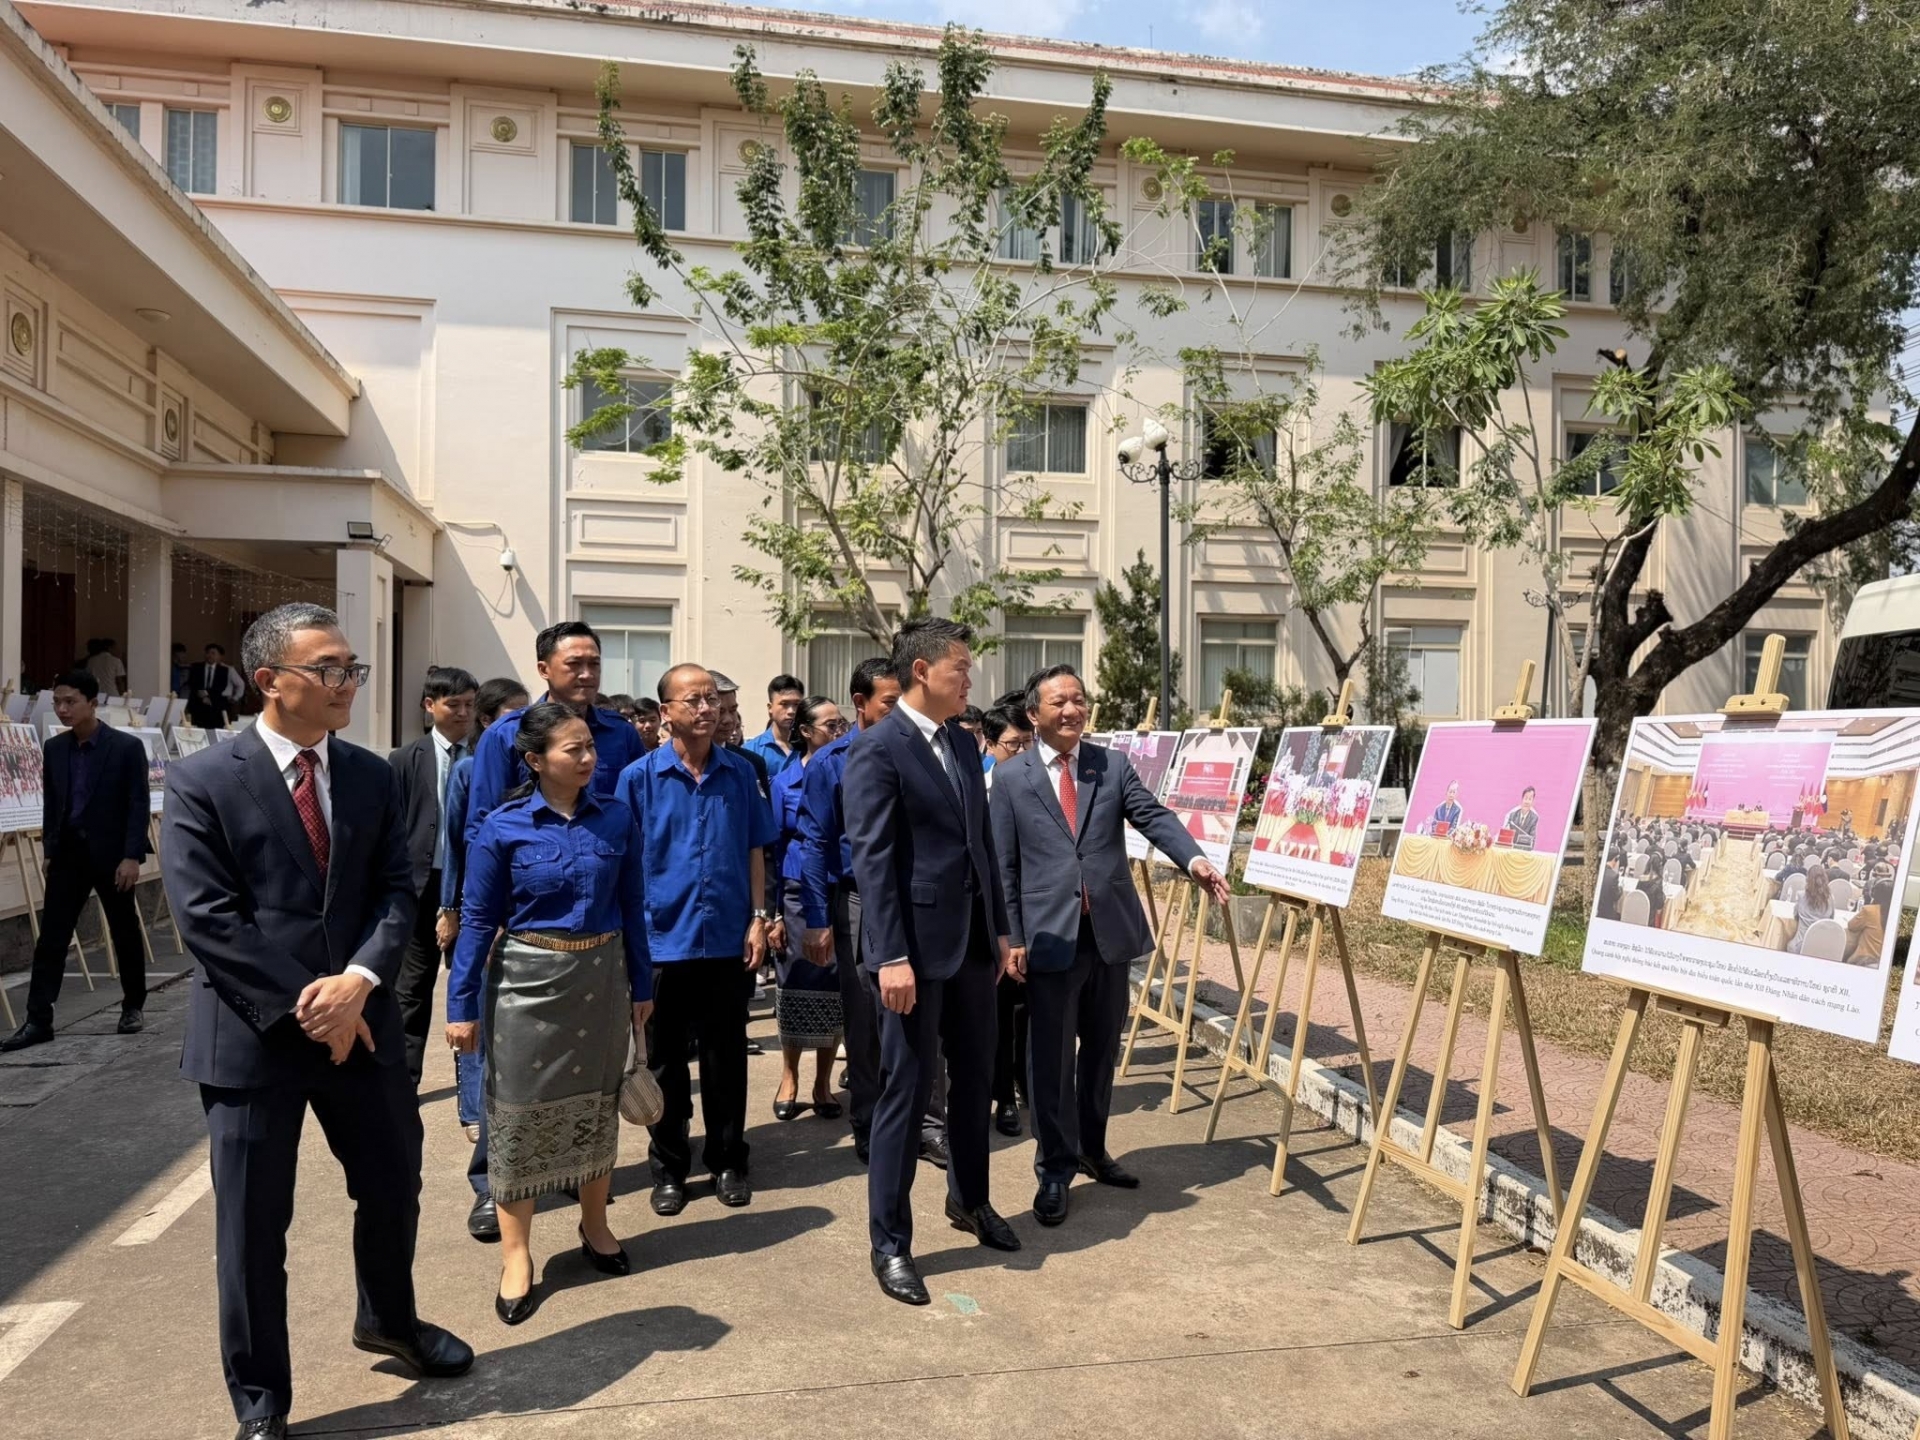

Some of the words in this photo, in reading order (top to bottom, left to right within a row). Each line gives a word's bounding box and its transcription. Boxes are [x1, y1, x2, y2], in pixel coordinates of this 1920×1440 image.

[1782, 989, 1798, 1000] Nhân
[1799, 993, 1810, 1003] dân
[1811, 996, 1826, 1006] cách
[1827, 1000, 1845, 1012] mạng
